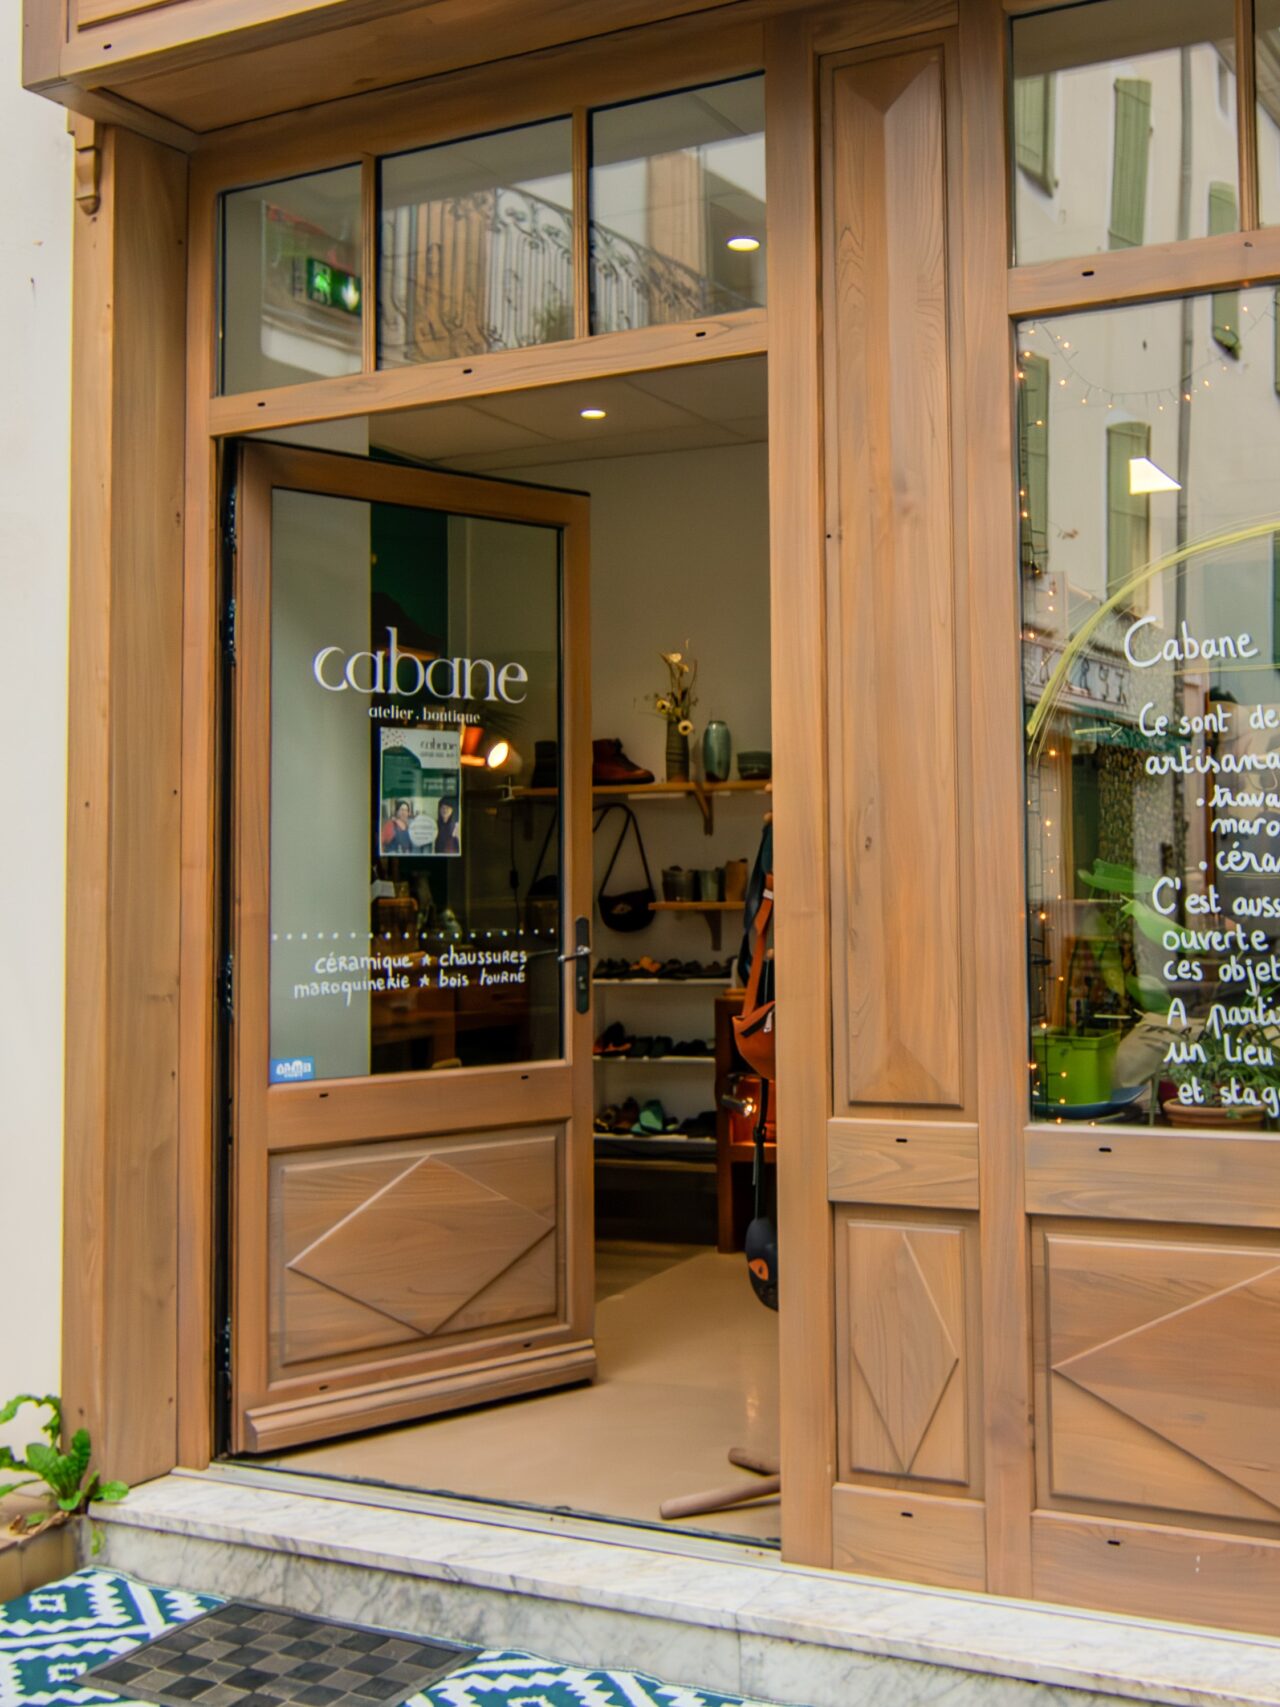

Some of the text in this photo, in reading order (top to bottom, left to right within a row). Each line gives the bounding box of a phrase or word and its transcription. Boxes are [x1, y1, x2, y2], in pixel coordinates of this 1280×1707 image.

[1124, 616, 1258, 667] Cabane
[313, 626, 528, 704] cabane
[369, 705, 480, 725] atelier boutique
[1139, 702, 1166, 737] Ce
[1179, 704, 1232, 736] sont
[1152, 876, 1222, 914] C'est
[1163, 924, 1269, 950] ouverte
[439, 969, 470, 988] bois
[479, 965, 526, 987] tourné
[1163, 960, 1203, 981] ces
[1167, 998, 1187, 1027] A
[1163, 1041, 1207, 1066] un
[1224, 1033, 1274, 1067] lieu
[1178, 1077, 1205, 1106] et
